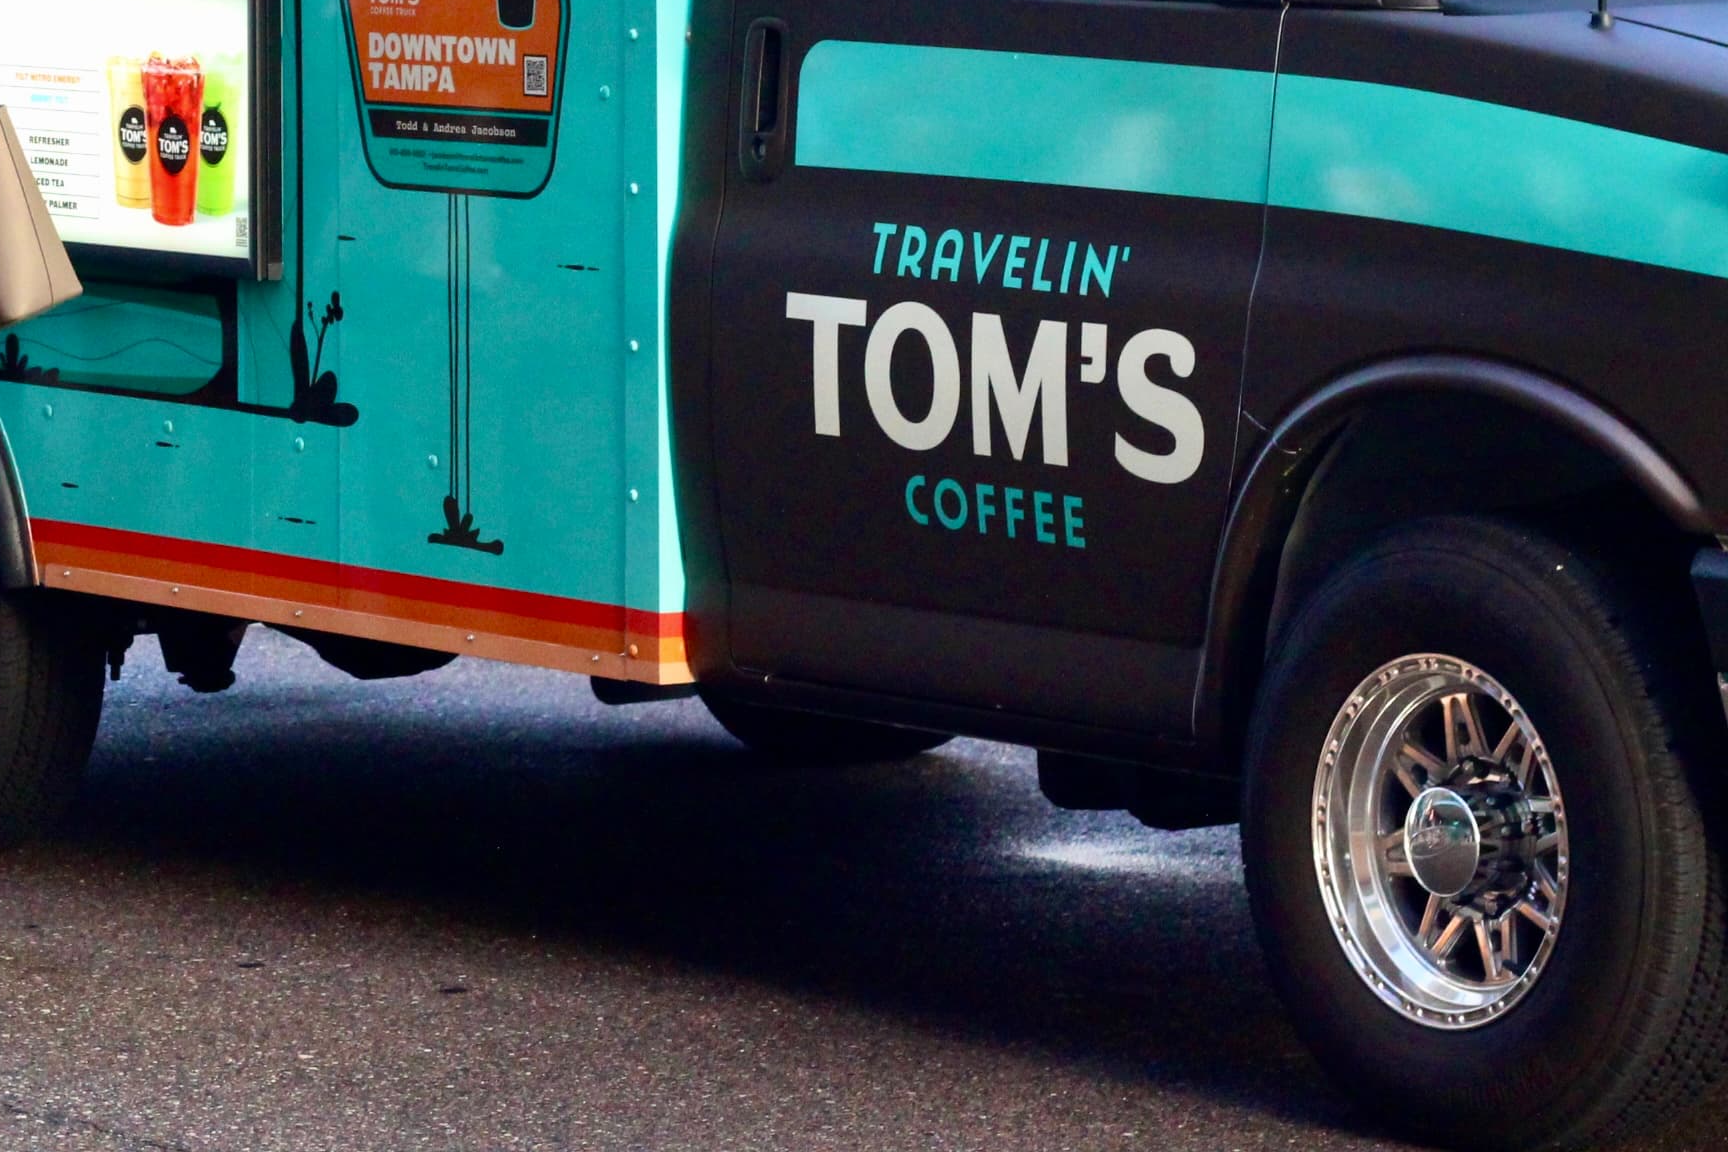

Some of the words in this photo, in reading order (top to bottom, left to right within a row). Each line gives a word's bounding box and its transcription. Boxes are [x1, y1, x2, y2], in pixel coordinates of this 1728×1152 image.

[368, 32, 516, 66] DOWNTOWN
[368, 62, 456, 93] TAMPA
[395, 120, 418, 131] Todd
[423, 122, 429, 131] &
[434, 123, 466, 134] Andrea
[471, 124, 516, 137] Jacobson
[29, 136, 70, 146] REFRESHER
[158, 138, 189, 154] TOM'S
[30, 157, 69, 167] LEMONADE
[35, 177, 50, 186] CED
[51, 178, 65, 188] TEA
[49, 200, 78, 210] PALMER
[873, 222, 1130, 299] TRAVELIN'
[785, 291, 1205, 485] TOM'S
[905, 475, 1086, 548] COFFEE
